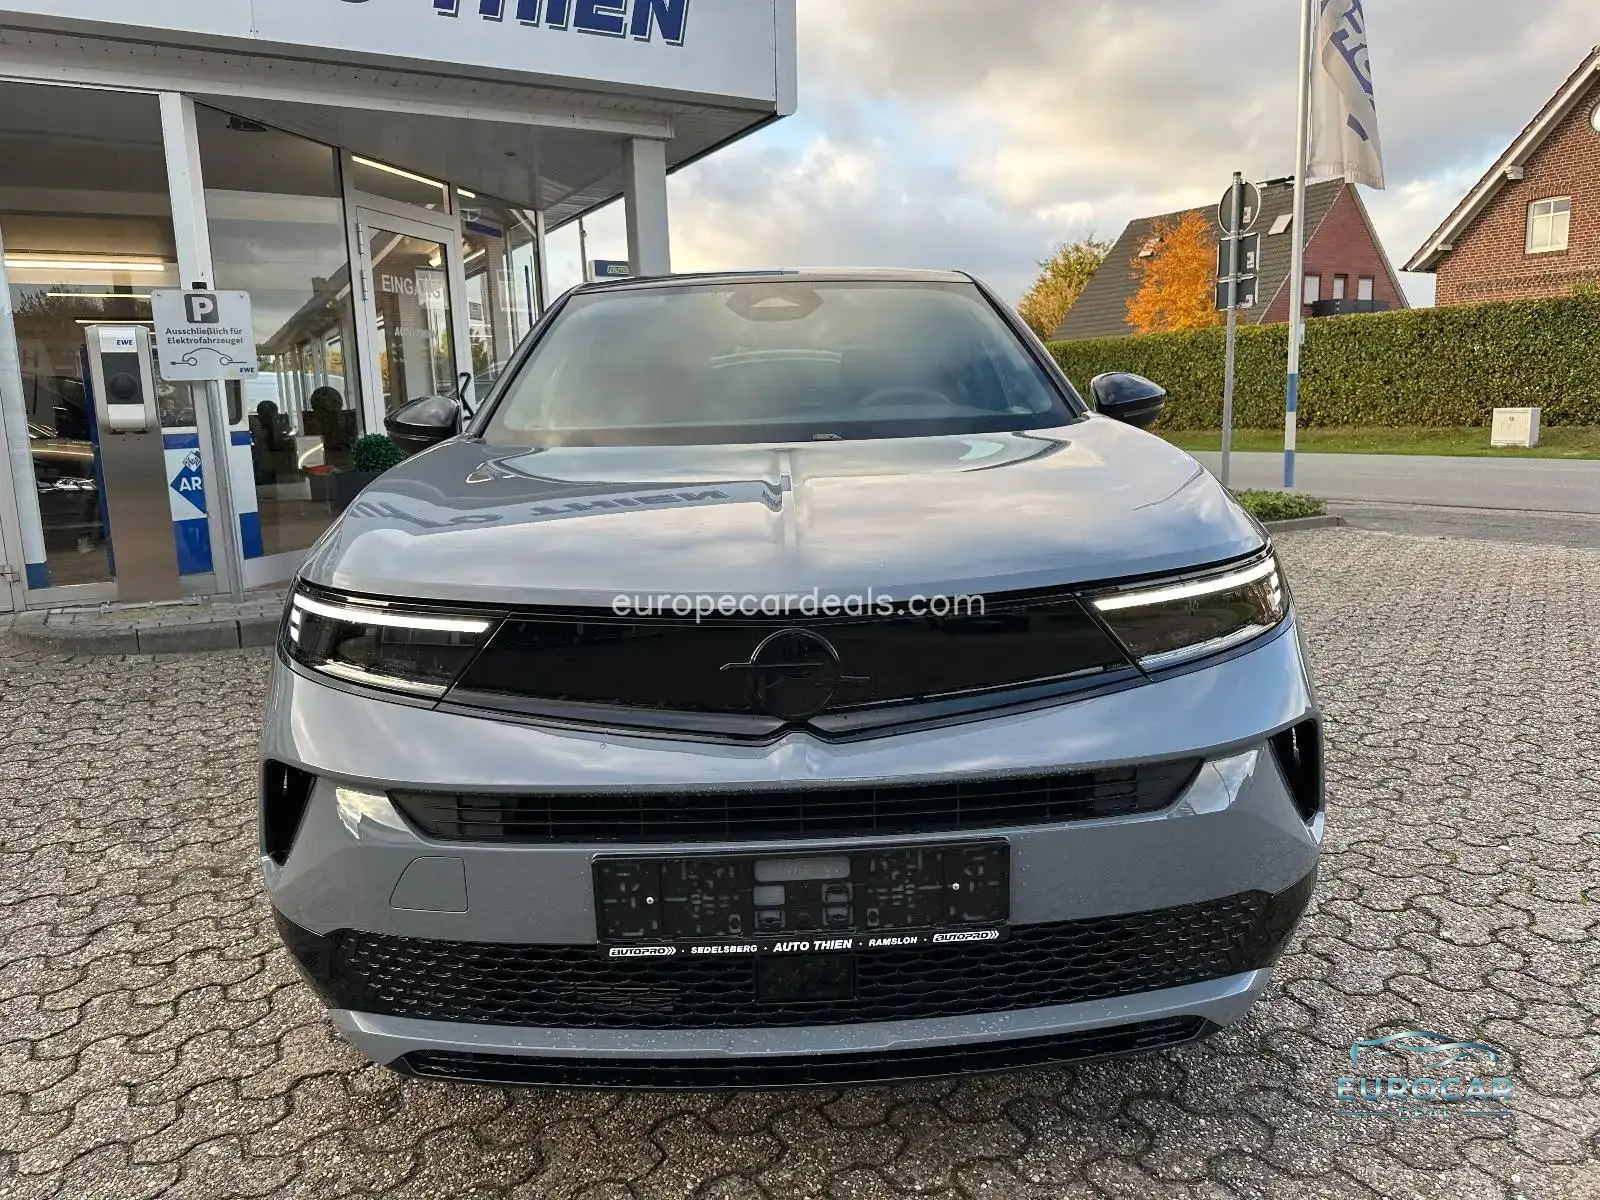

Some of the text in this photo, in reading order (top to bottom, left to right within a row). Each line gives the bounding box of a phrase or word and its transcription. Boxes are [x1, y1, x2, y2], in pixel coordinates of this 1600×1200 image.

[191, 296, 214, 322] P
[165, 327, 242, 336] Ausschließlich für
[167, 337, 244, 345] Elektrofahrzeuge!
[179, 476, 202, 491] AR
[690, 945, 758, 954] SEDELSBERG
[773, 941, 809, 952] AUTO
[813, 939, 852, 950] THIEN
[868, 936, 917, 947] RAMSLOH
